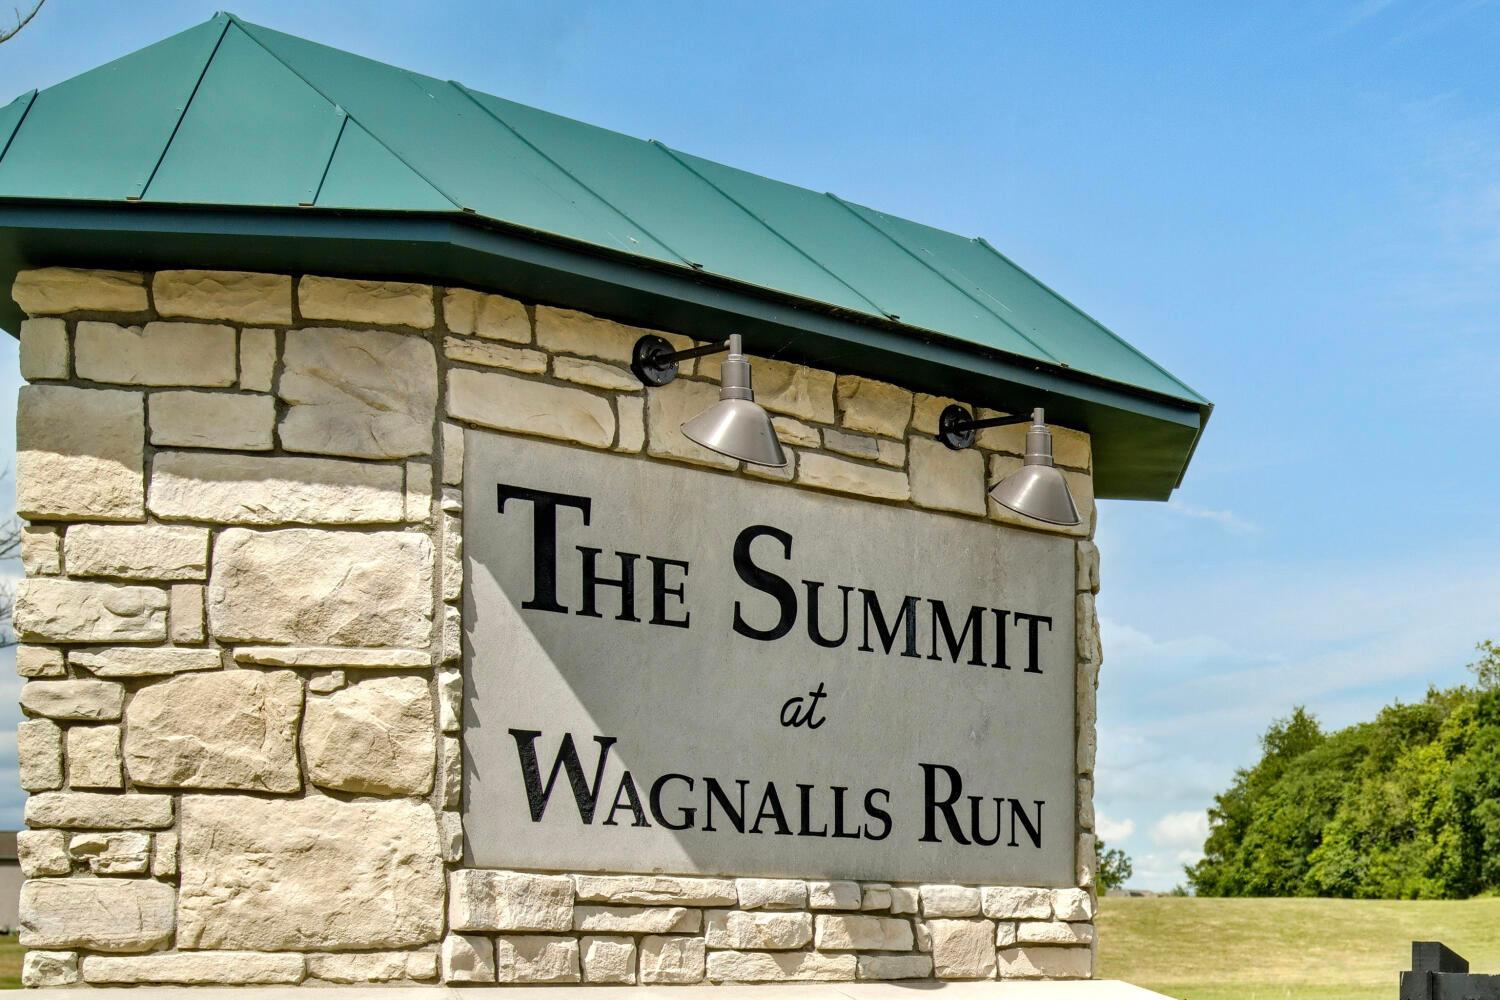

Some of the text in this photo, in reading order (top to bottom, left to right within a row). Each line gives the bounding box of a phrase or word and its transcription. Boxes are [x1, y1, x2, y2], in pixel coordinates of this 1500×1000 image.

[496, 483, 1053, 675] THE SUMMIT
[779, 681, 828, 730] at
[508, 728, 1046, 849] WAGNALLS RUN
